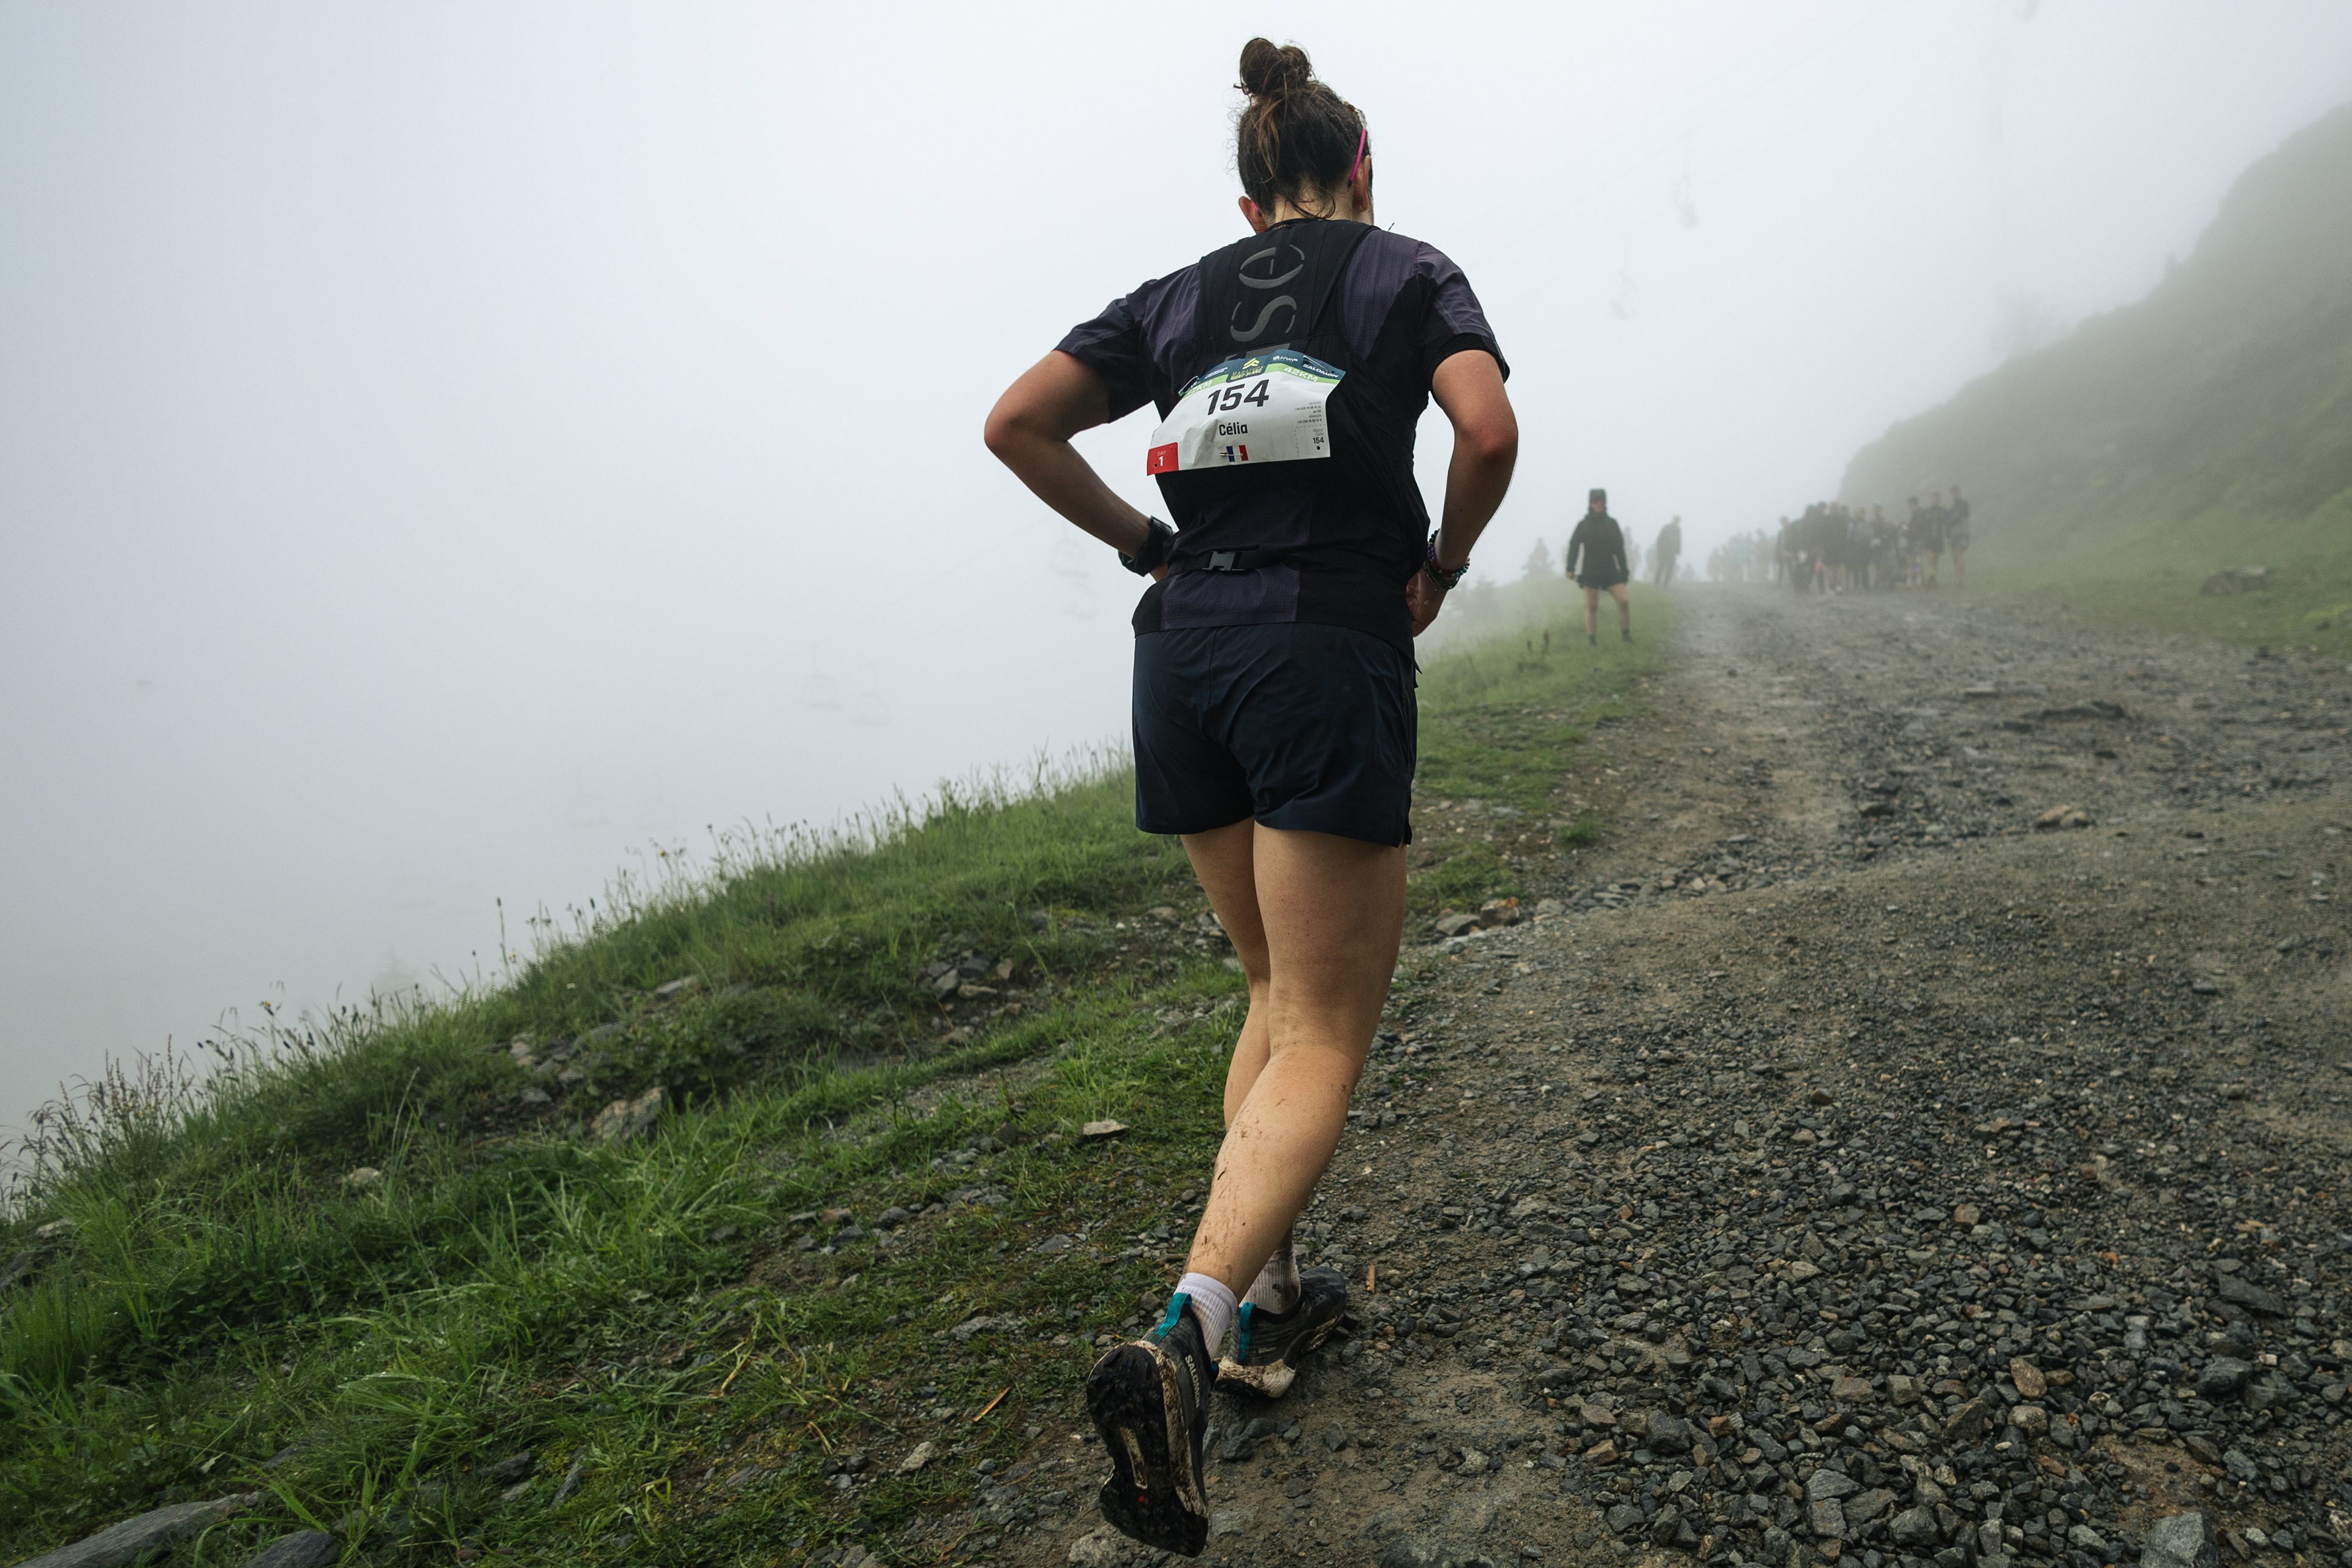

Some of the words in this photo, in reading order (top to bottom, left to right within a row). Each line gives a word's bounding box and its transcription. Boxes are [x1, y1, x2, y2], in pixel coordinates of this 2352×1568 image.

[1224, 245, 1305, 362] se
[1284, 367, 1318, 382] 42KM
[1303, 364, 1338, 378] SALOMON
[1207, 379, 1269, 415] 154
[1219, 422, 1248, 435] Célia
[1159, 456, 1163, 466] 1
[1185, 1354, 1200, 1408] SALOMON
